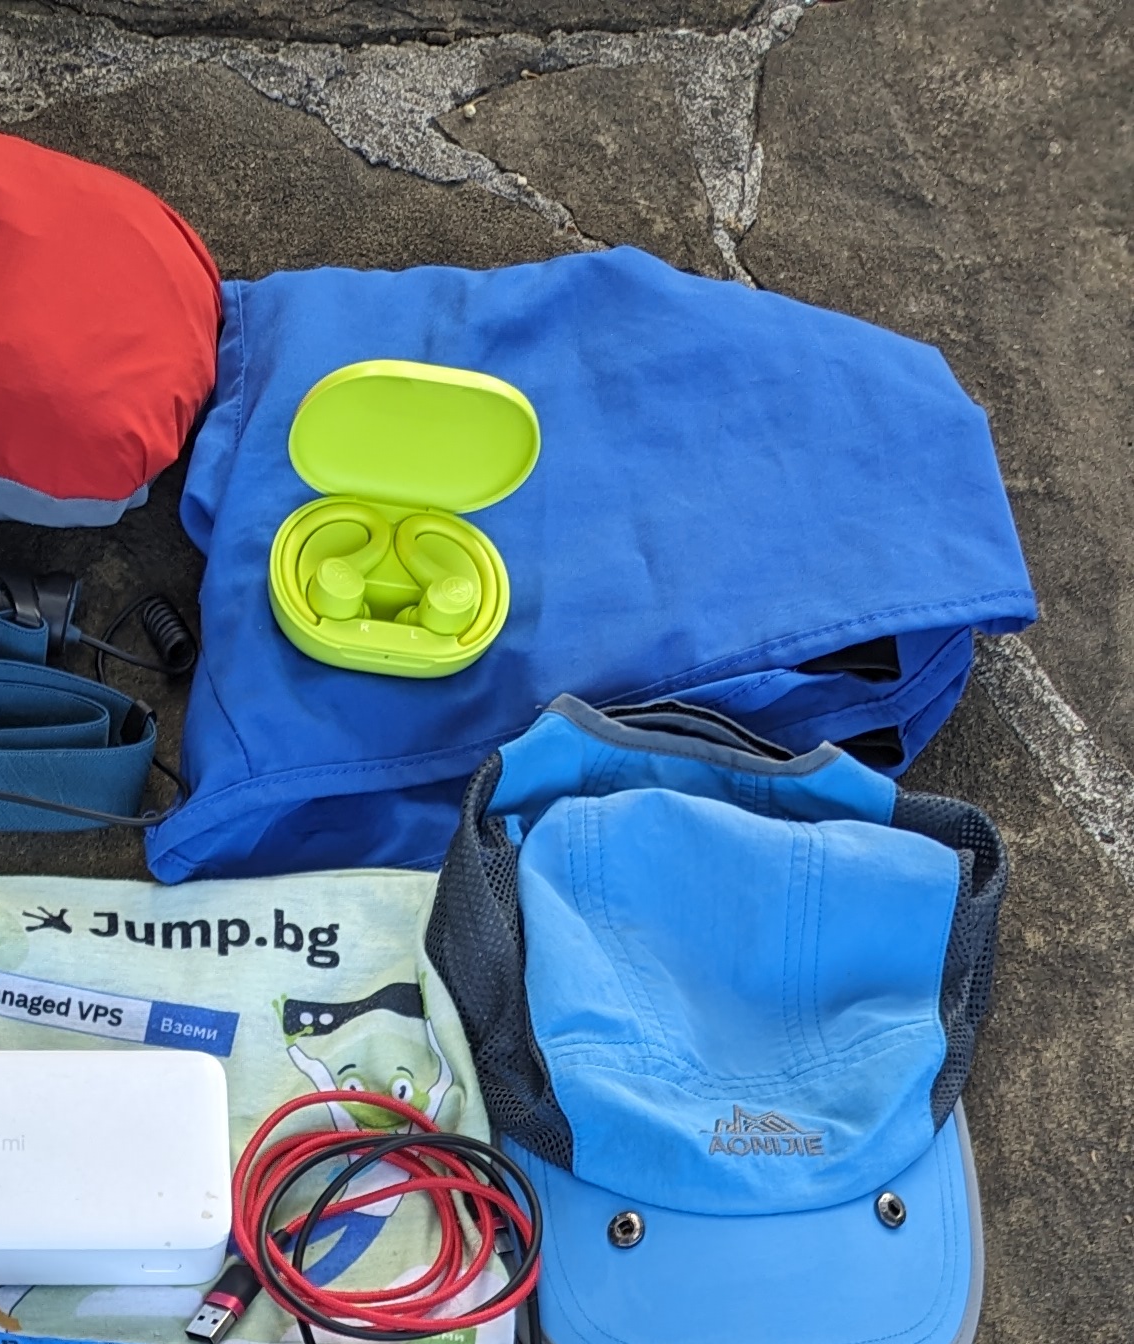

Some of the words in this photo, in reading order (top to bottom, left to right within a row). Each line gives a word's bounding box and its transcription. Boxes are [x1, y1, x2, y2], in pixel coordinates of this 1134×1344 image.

[89, 909, 340, 968] Jump.bg
[77, 1000, 123, 1028] VPS
[160, 1018, 218, 1042] Вземи
[708, 1134, 825, 1156] AONIJIE
